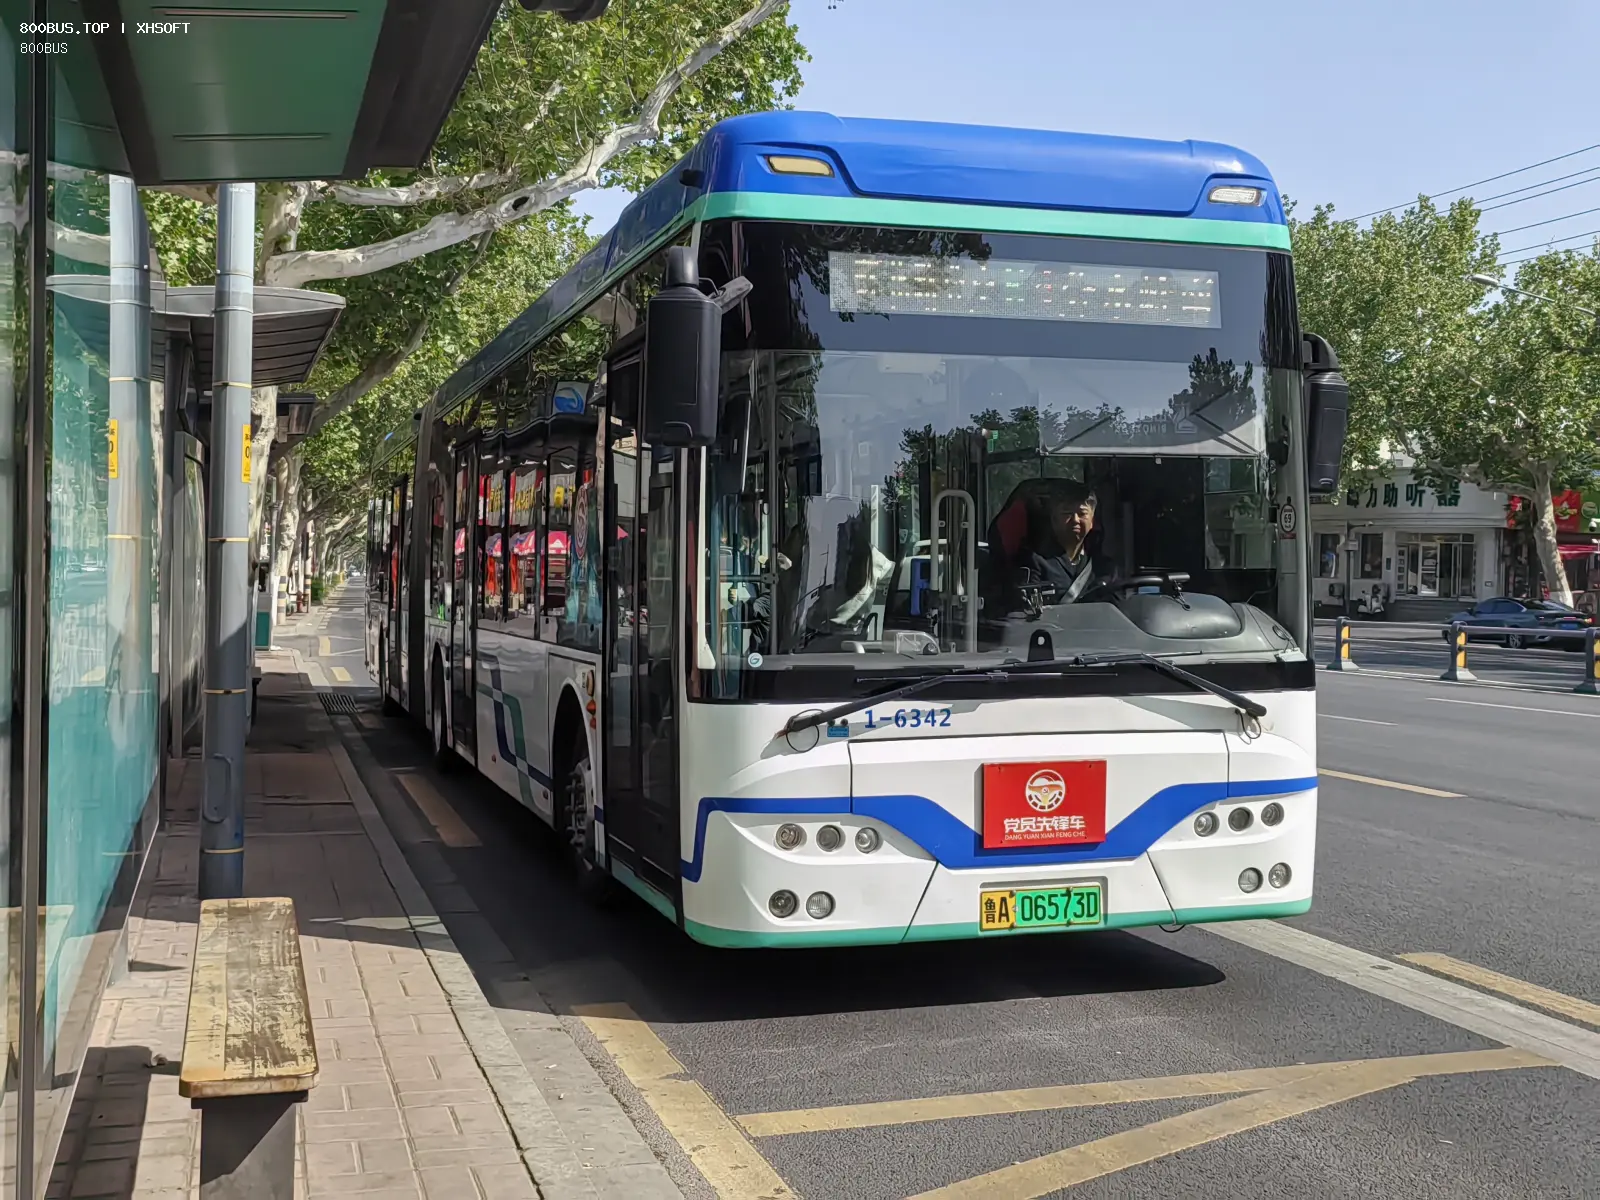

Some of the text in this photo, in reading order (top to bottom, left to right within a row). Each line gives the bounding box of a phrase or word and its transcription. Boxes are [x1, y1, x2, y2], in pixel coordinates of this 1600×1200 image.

[864, 708, 952, 729] 1-6342
[1003, 815, 1086, 833] 党员先锋车
